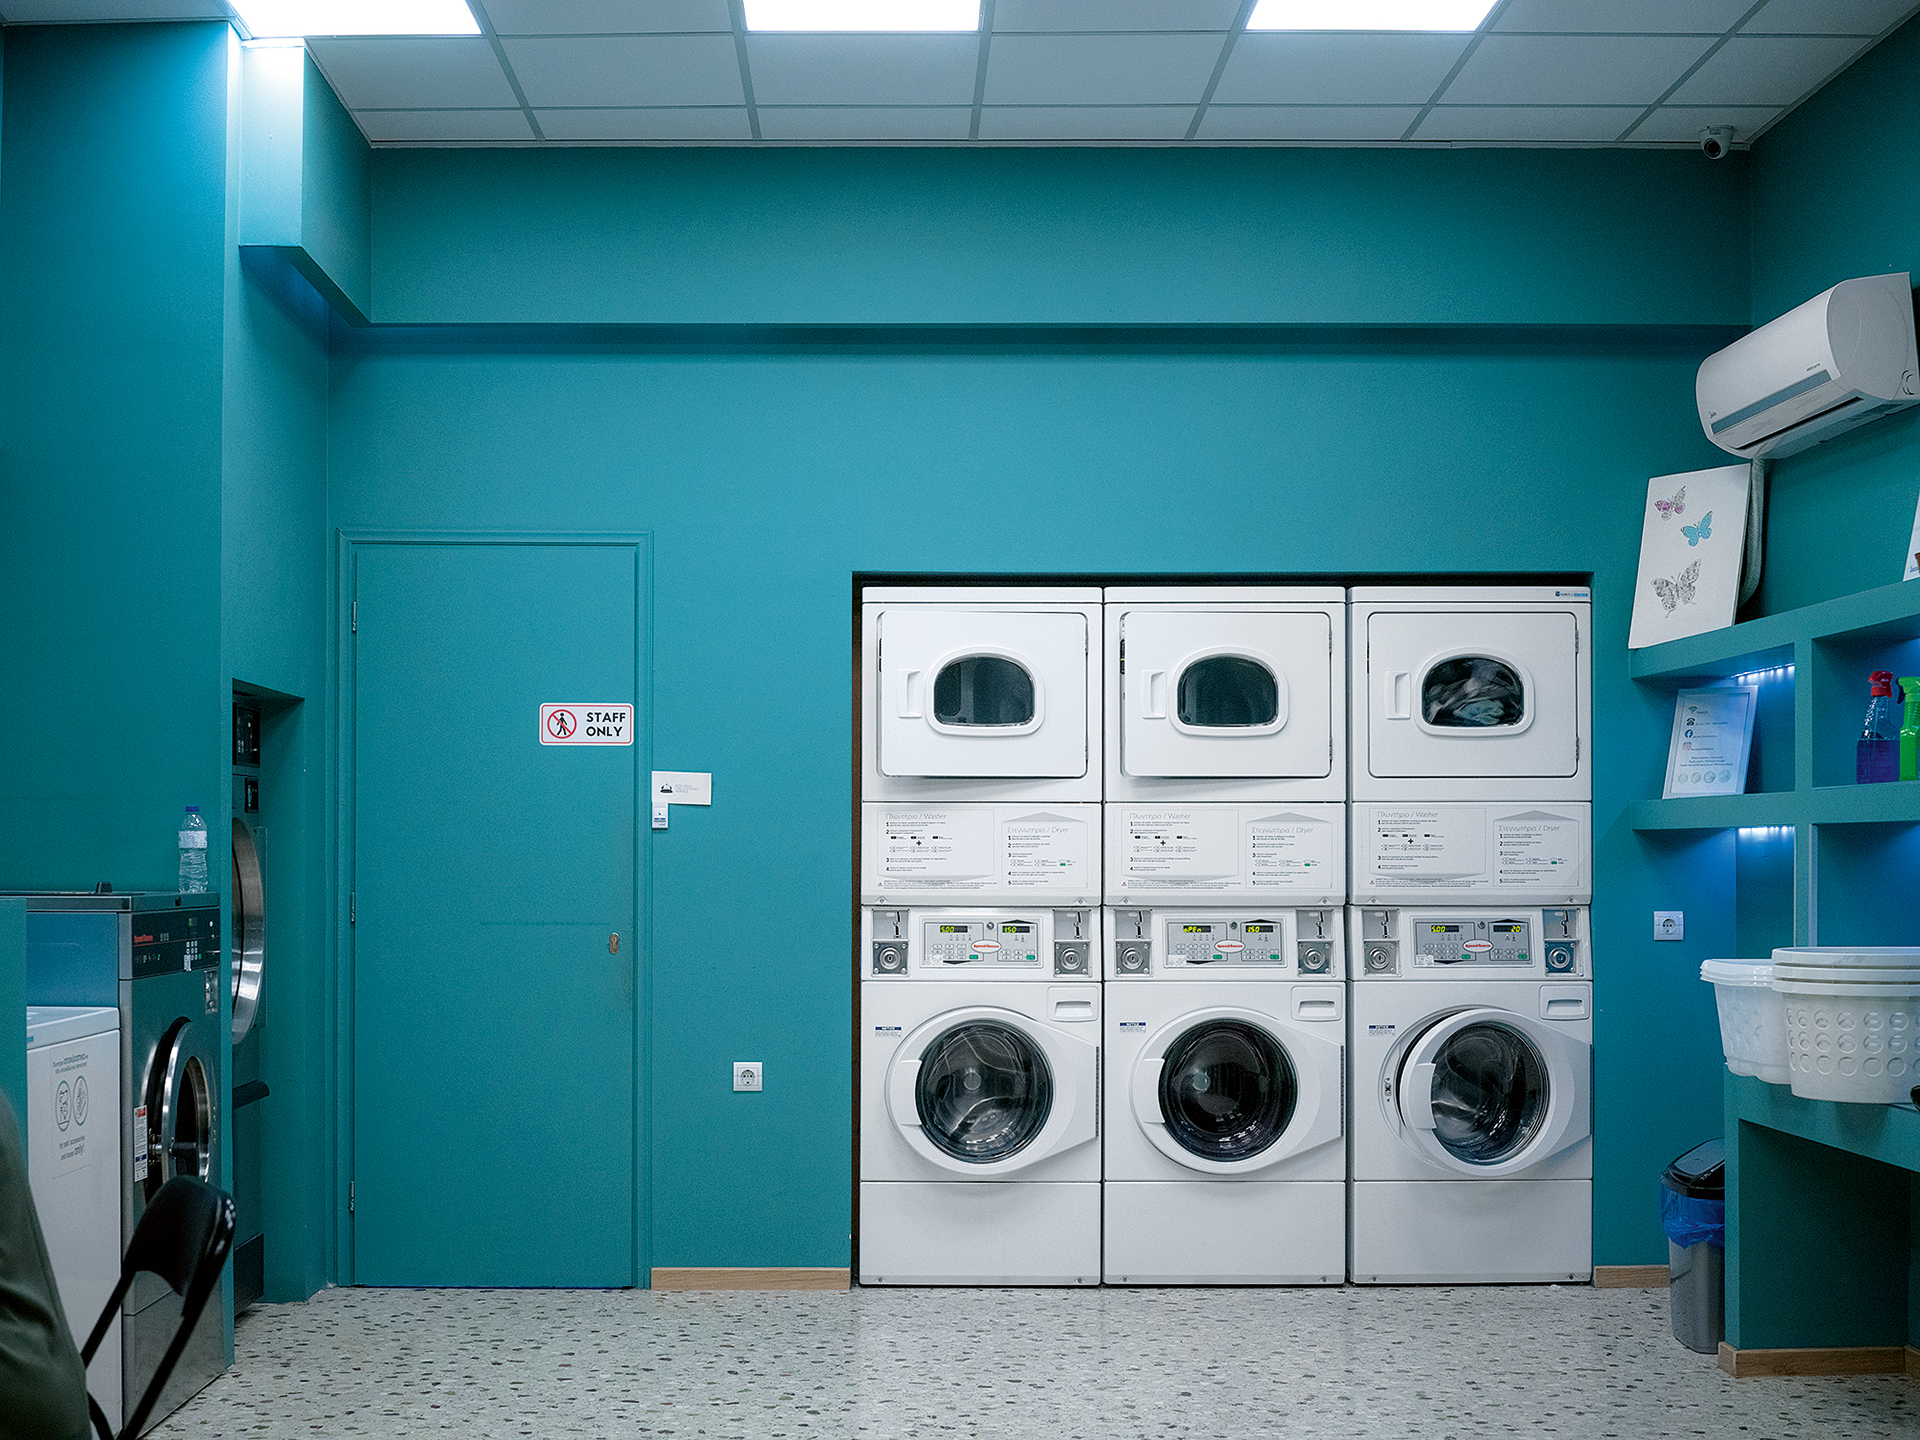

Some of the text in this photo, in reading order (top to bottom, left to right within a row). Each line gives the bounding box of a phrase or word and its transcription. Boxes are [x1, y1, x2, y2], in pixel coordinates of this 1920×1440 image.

[586, 712, 626, 723] STAFF
[586, 726, 623, 737] ONLY
[1007, 826, 1045, 834] Στεγνωτήριο
[1052, 826, 1069, 834] Dryer
[1251, 826, 1290, 834] Στεγνωτήριο
[1296, 826, 1313, 834] Dryer
